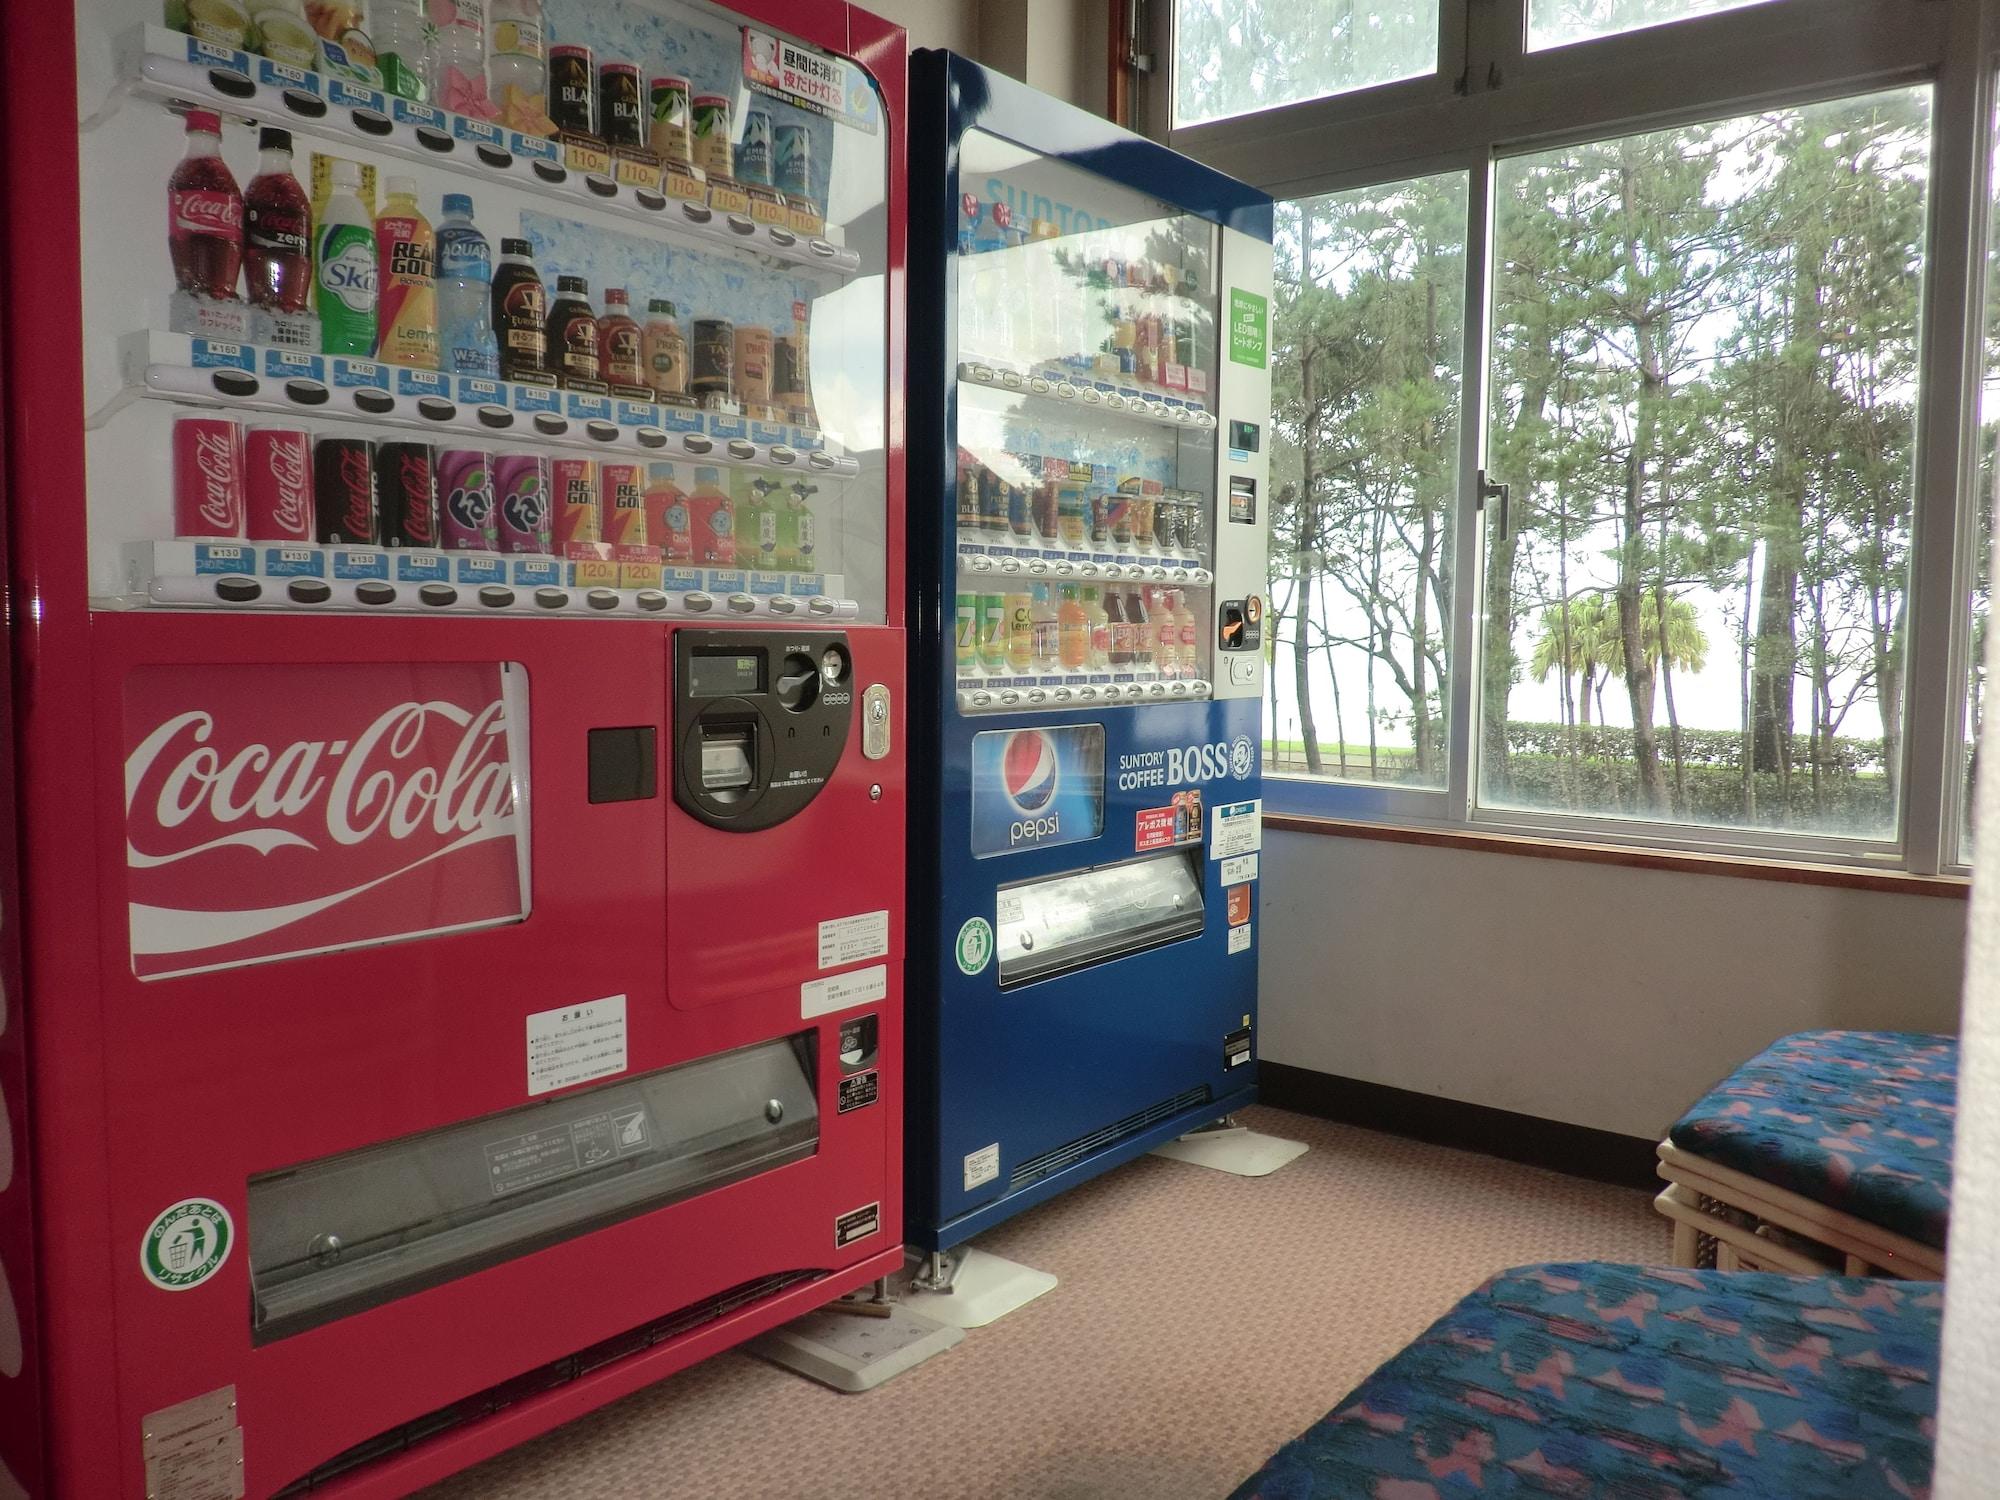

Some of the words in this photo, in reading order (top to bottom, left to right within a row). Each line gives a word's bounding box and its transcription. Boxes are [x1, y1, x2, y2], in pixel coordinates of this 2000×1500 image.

[784, 49, 842, 86] 昼間は消灯
[783, 69, 842, 106] 夜だけ灯る
[276, 232, 308, 247] zero
[211, 343, 237, 354] ¥160
[213, 549, 238, 557] ¥130
[284, 552, 309, 560] ¥130
[1119, 750, 1165, 770] SUNTORY
[1167, 742, 1228, 786] BOSS
[125, 700, 514, 866] Coca-Cola
[1118, 768, 1164, 791] COFFEE
[1010, 811, 1060, 846] pepsi
[153, 1204, 223, 1239] のんだあとは
[158, 1255, 218, 1284] リサイクル
